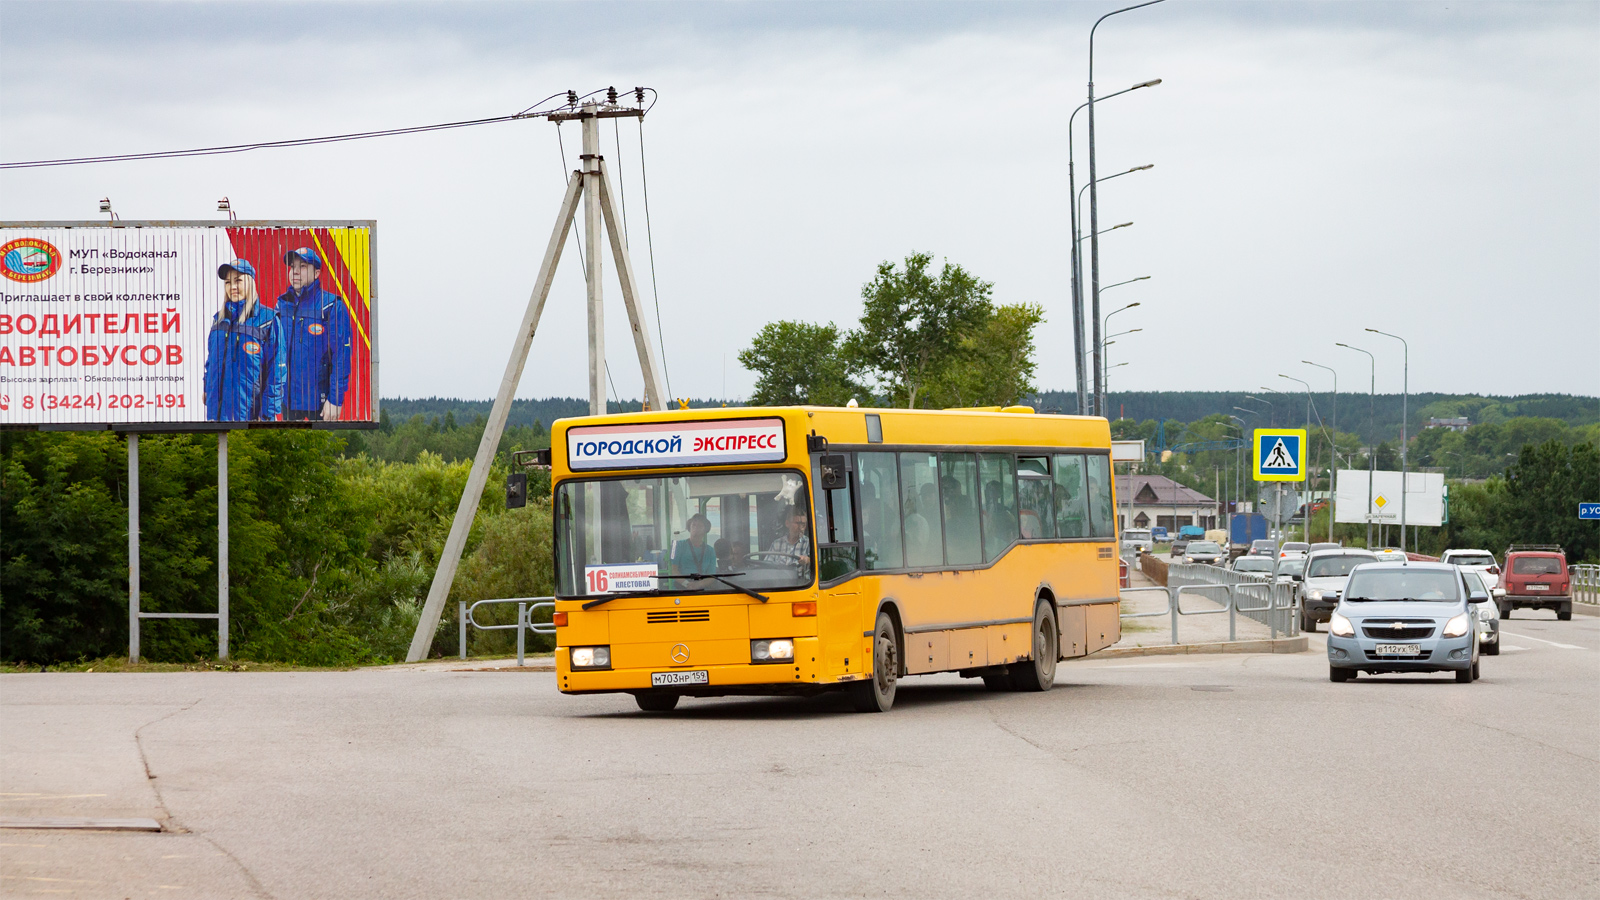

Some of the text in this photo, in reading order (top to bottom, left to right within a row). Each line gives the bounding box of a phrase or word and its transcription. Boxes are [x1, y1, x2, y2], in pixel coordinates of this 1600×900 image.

[69, 249, 178, 260] МУП «Водоканал
[69, 264, 154, 275] г. Березники»
[84, 292, 113, 302] свой
[116, 292, 181, 301] коллектив
[0, 308, 181, 338] ВОДИТЕЛЕЙ
[0, 345, 183, 366] АВТОБУСОВ
[22, 392, 186, 411] 8 (3424) 202-191
[576, 434, 777, 456] ГОРОДСКОЙ ЭКСПРЕСС
[586, 569, 608, 592] 16
[615, 580, 651, 588] КЛЕСТОВКА
[654, 672, 705, 684] М703НР 159
